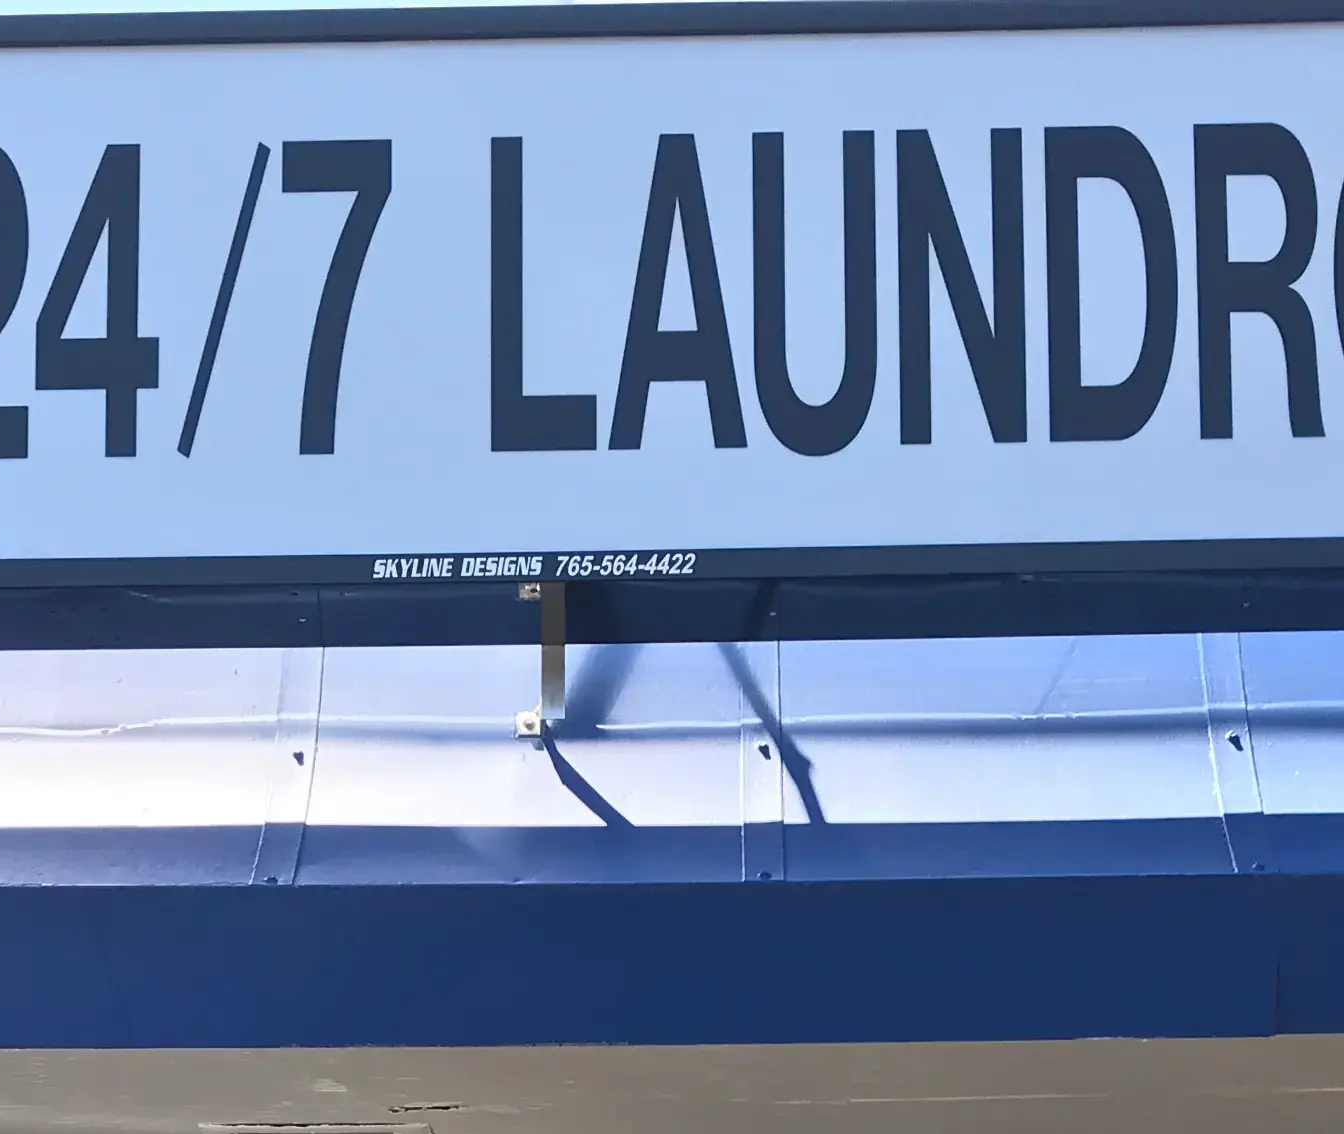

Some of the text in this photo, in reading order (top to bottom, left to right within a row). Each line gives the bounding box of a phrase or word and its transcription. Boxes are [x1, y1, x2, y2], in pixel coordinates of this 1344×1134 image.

[372, 553, 697, 579] SKYLINE DESIGNS 765-564-4422
